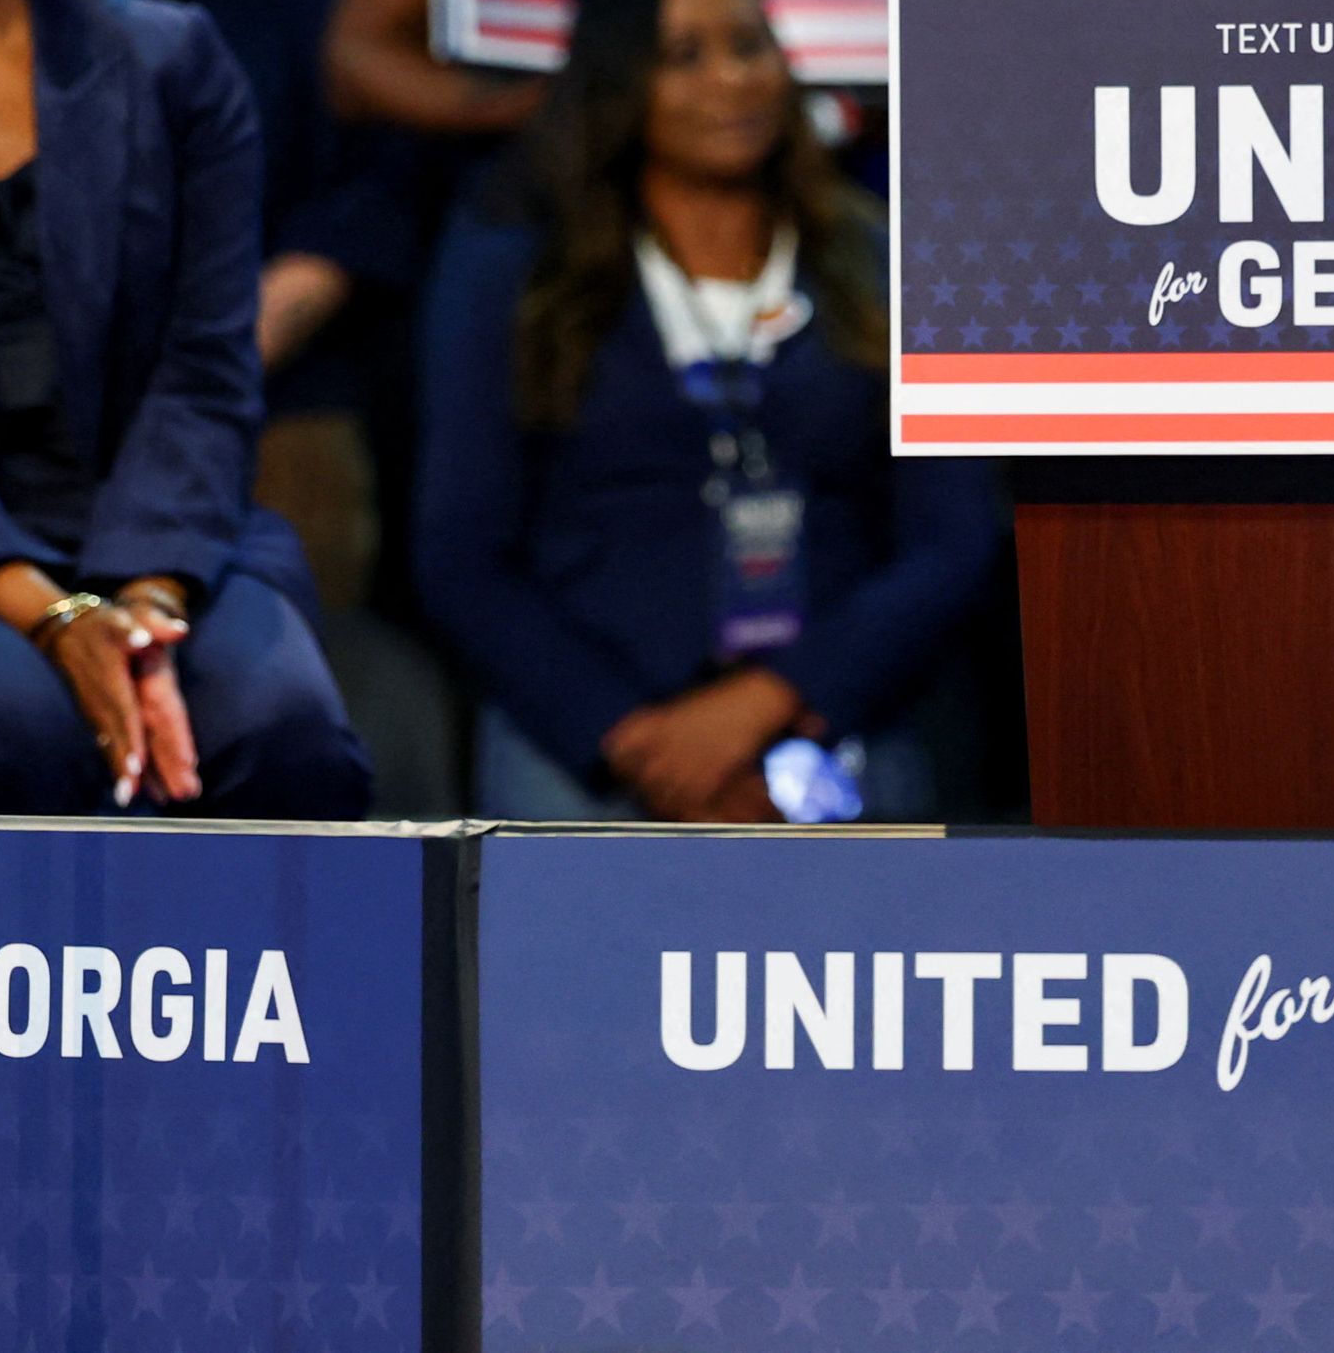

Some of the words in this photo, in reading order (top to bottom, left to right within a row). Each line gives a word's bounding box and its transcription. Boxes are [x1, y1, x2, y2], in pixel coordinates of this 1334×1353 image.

[1215, 22, 1303, 54] TEXT
[1148, 261, 1208, 326] for
[660, 951, 1189, 1072] UNITED
